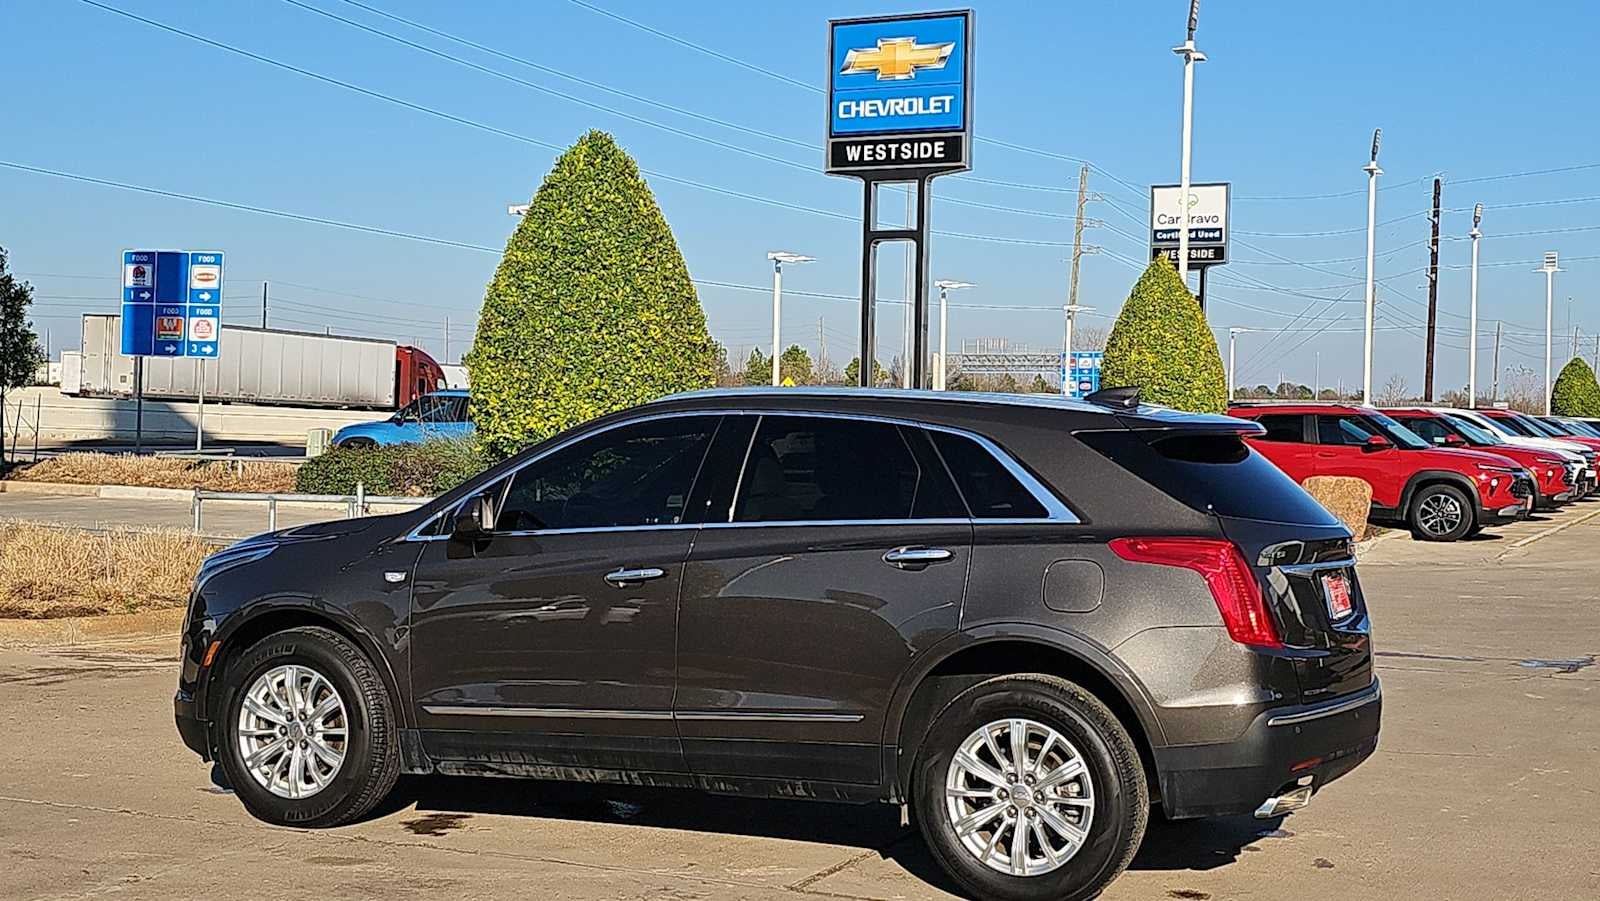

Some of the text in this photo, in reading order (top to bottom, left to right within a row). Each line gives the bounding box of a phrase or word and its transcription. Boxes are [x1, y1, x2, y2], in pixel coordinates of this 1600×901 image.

[838, 95, 954, 119] CHEVROLET
[846, 141, 945, 161] WESTSIDE
[1157, 214, 1219, 224] Carravo
[1198, 230, 1220, 238] Used
[191, 344, 198, 353] 3
